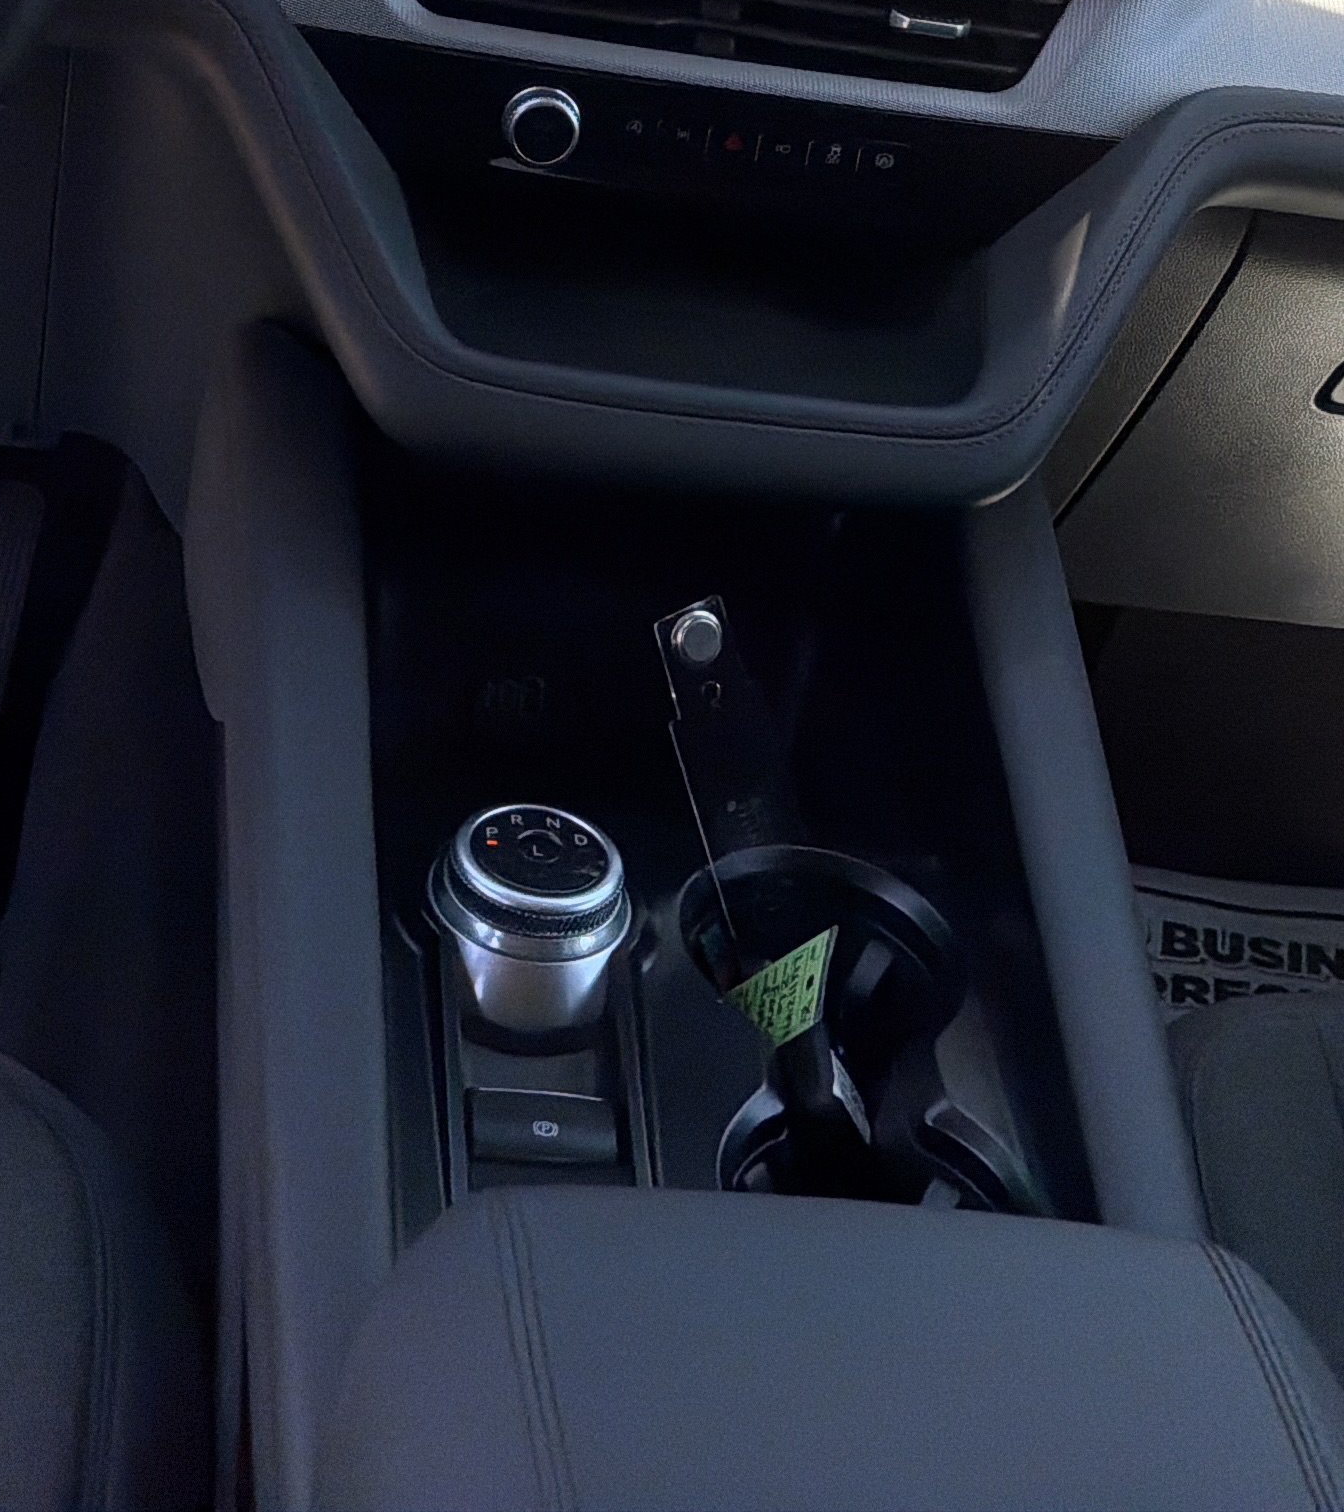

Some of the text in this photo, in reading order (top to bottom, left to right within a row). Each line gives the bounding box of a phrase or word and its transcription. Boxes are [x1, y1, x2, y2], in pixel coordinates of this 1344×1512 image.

[510, 814, 524, 826] R
[546, 816, 561, 829] N
[486, 827, 500, 839] P
[575, 834, 589, 847] D
